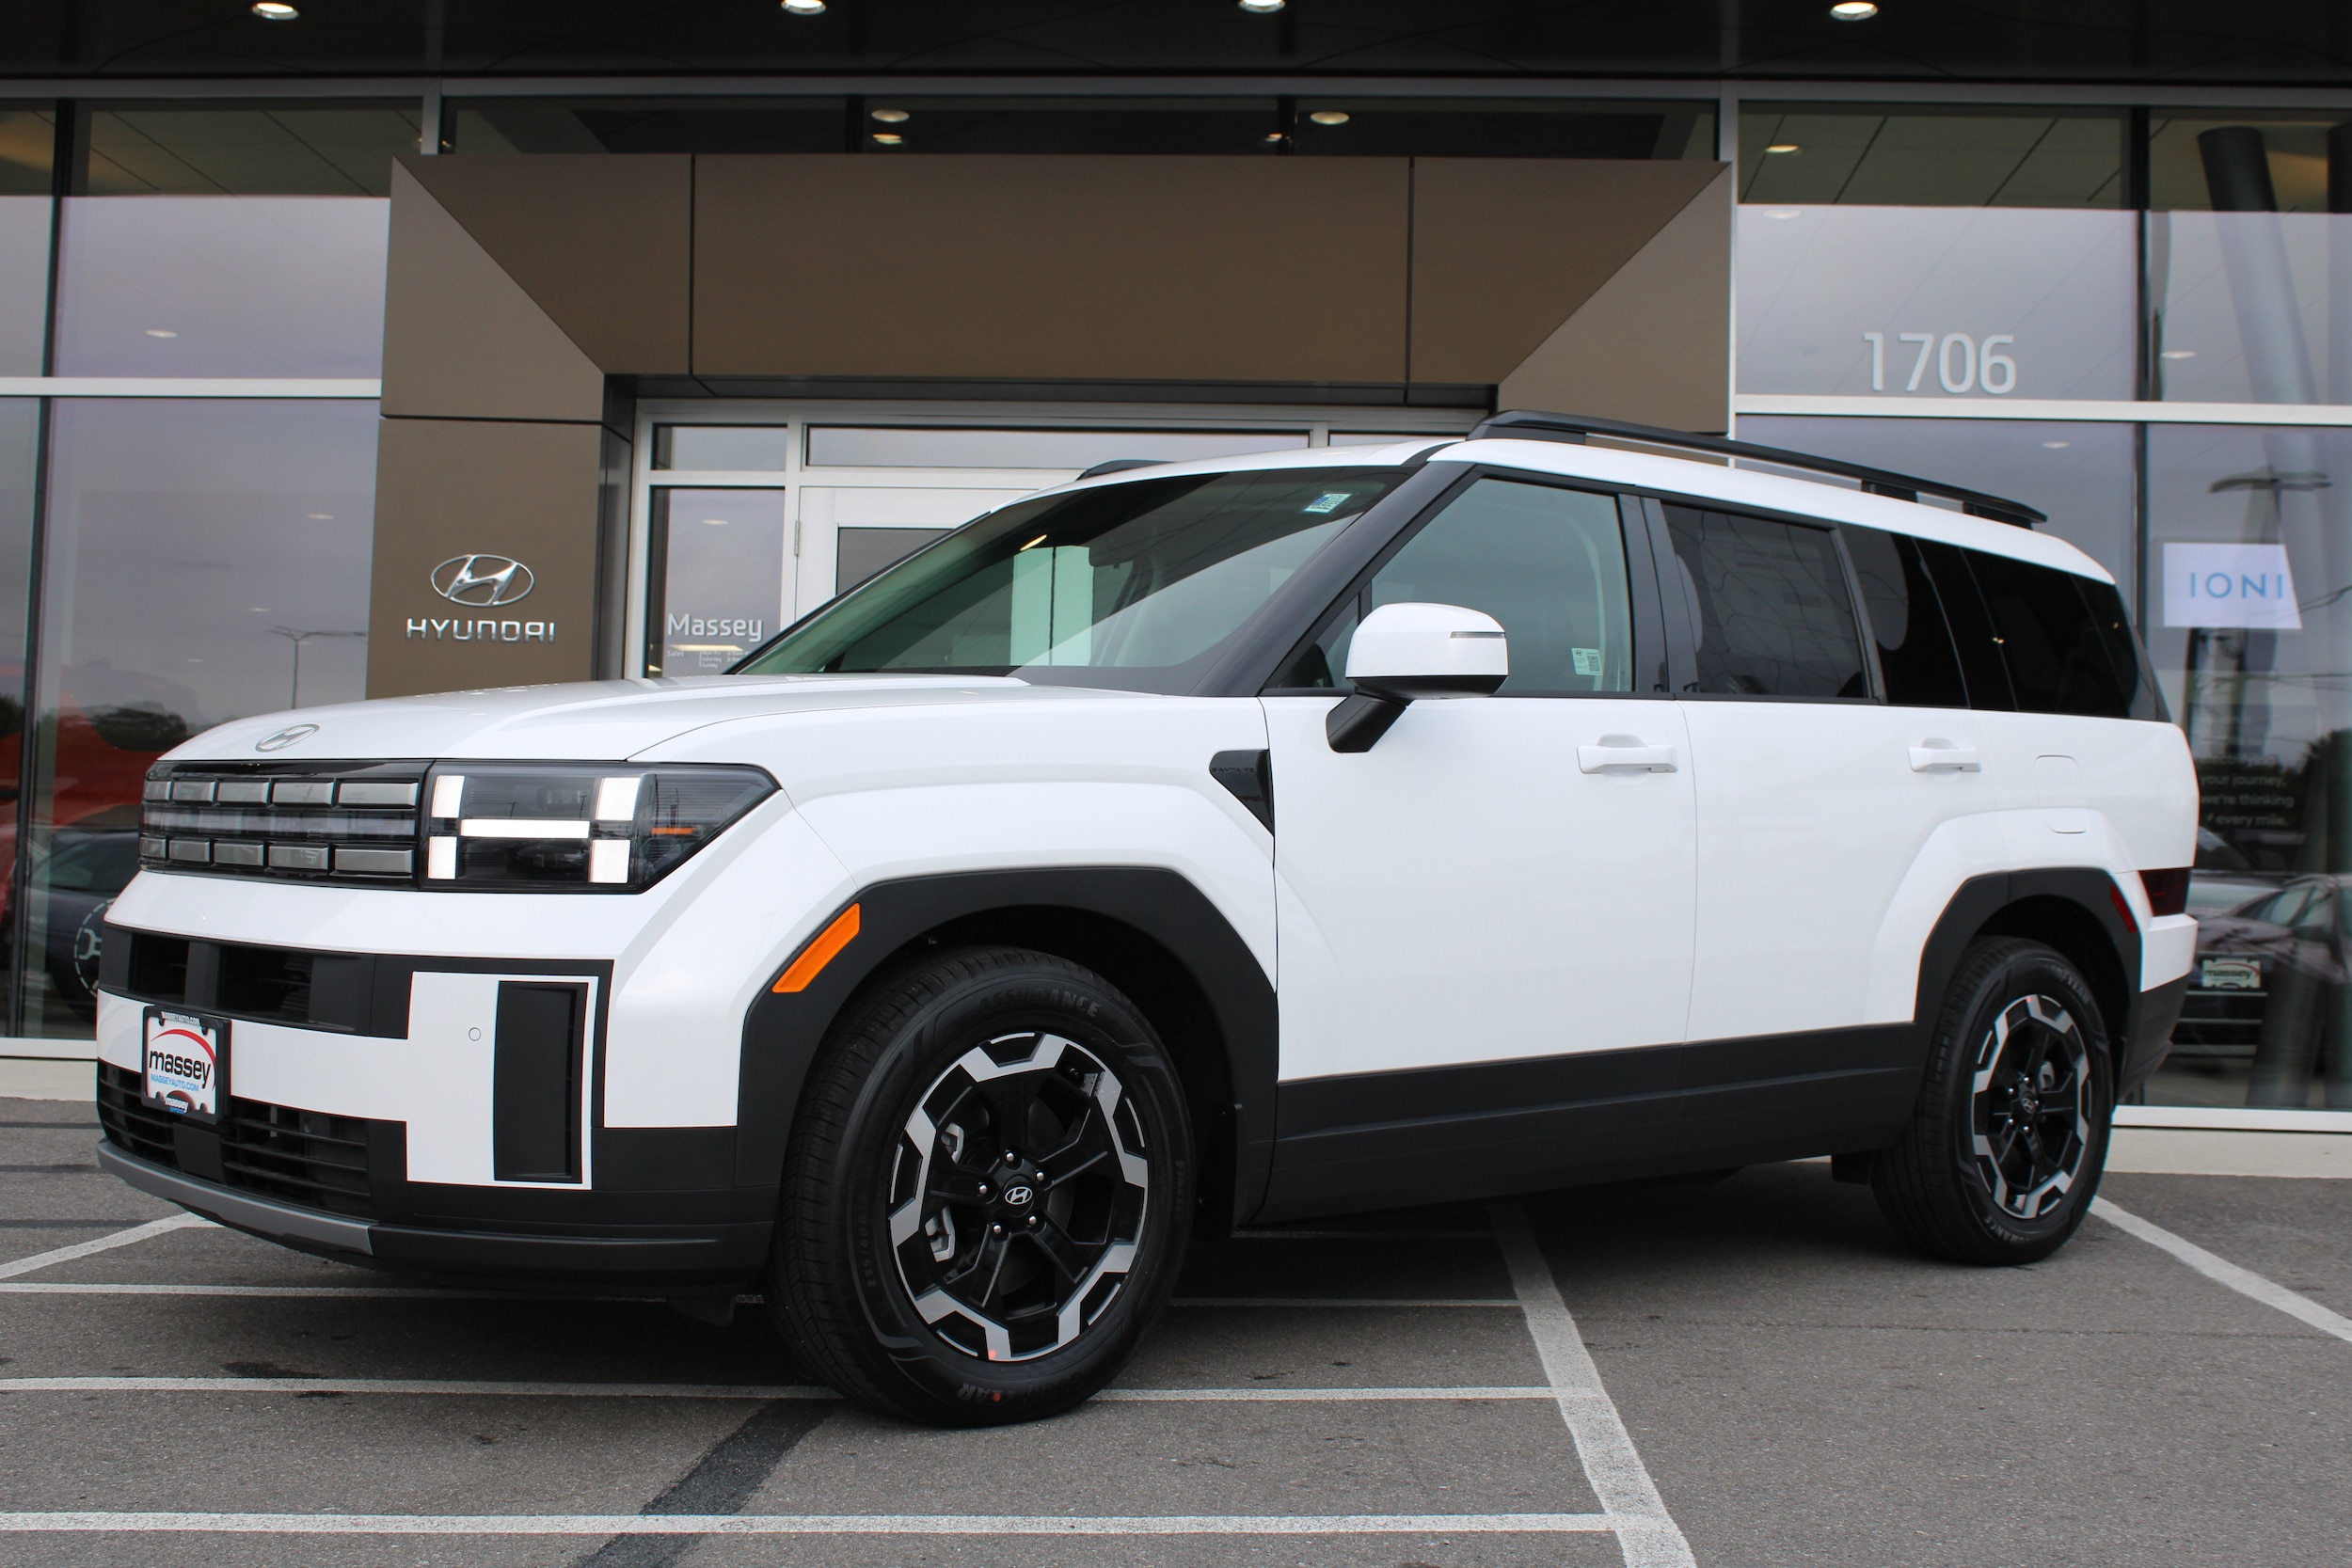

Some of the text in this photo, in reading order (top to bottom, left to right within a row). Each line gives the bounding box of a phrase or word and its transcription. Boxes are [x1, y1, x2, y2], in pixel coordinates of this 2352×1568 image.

[1862, 332, 2017, 395] 1706
[2189, 572, 2283, 599] IONI
[406, 617, 555, 643] HYUNDAI
[667, 613, 764, 642] Massey
[149, 1050, 211, 1089] massey
[151, 1073, 199, 1092] MASSEYAUTO.COM
